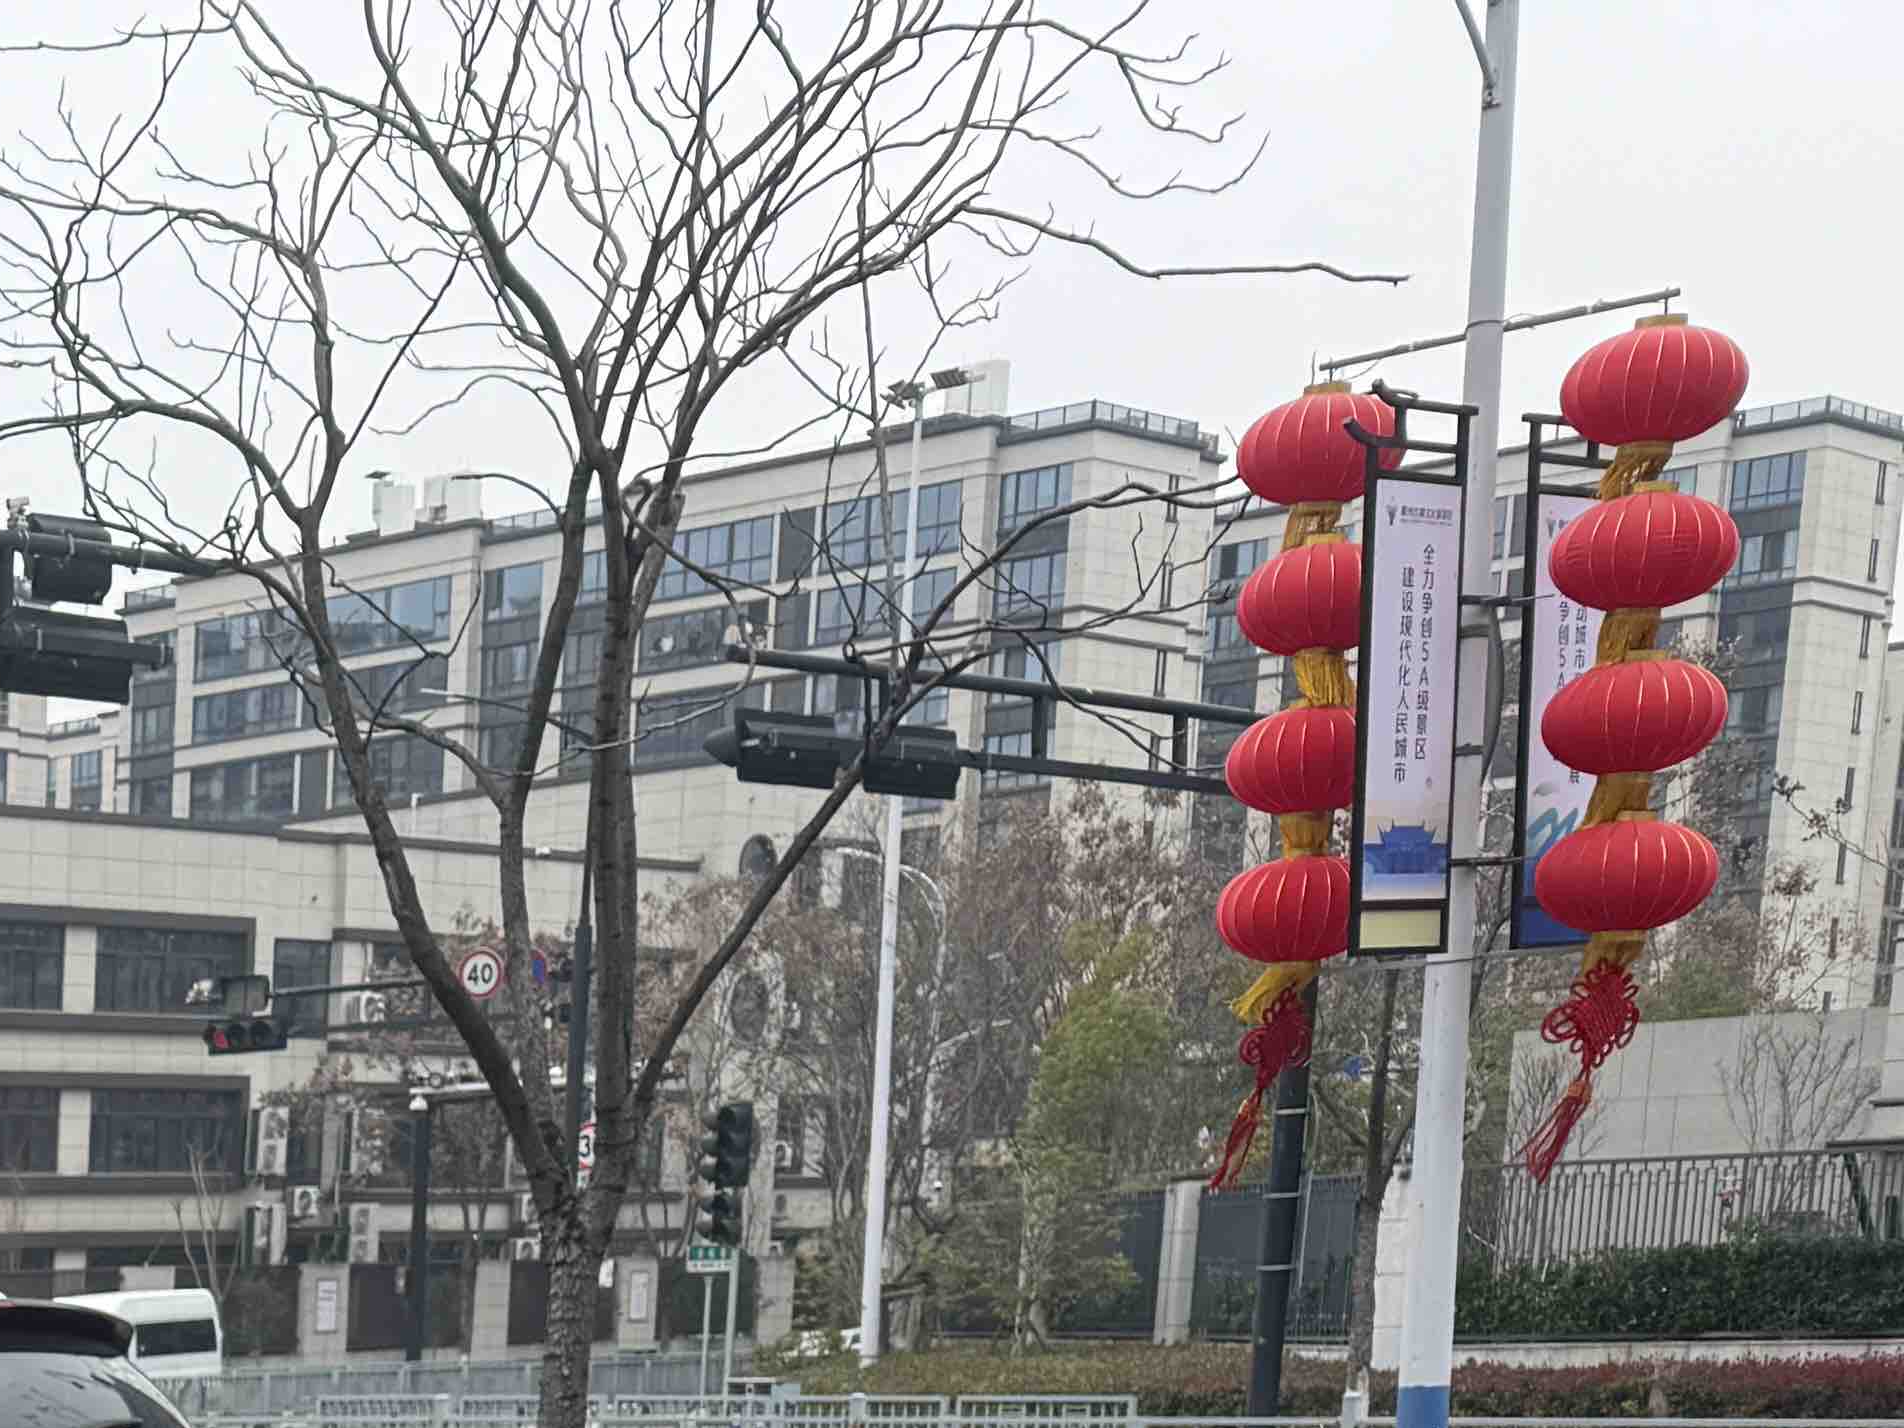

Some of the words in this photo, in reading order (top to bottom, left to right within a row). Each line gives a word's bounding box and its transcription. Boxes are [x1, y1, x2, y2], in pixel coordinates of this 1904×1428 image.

[1394, 566, 1415, 784] 建设现代化人民城市
[1415, 543, 1435, 760] 全力争创5A级景区
[467, 962, 493, 986] 40
